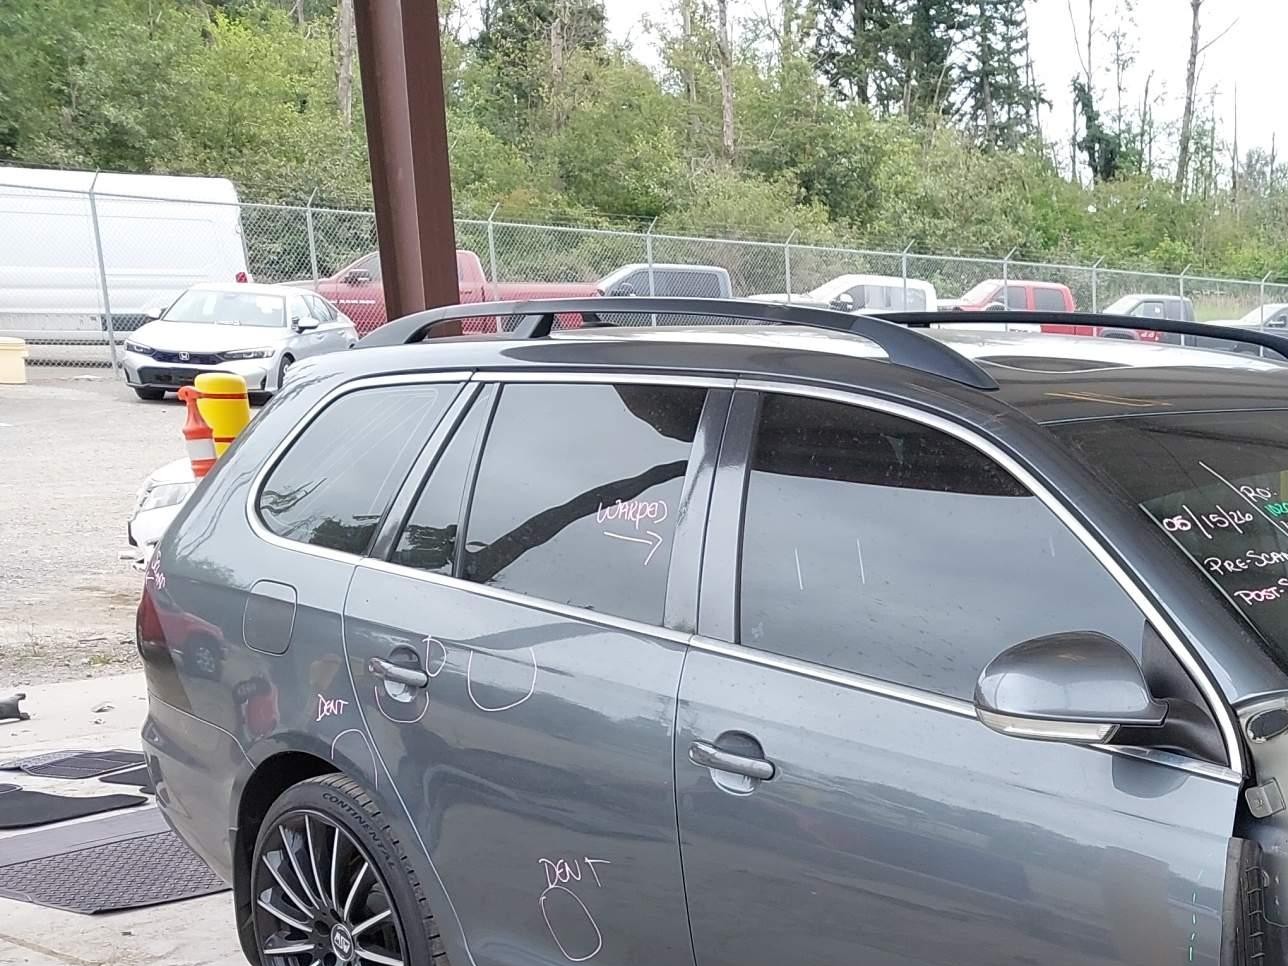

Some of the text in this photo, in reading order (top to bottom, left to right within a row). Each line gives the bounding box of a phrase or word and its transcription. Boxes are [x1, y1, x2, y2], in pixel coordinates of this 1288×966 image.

[1240, 485, 1278, 502] RO:
[316, 693, 349, 722] DENT
[538, 856, 611, 888] DENT
